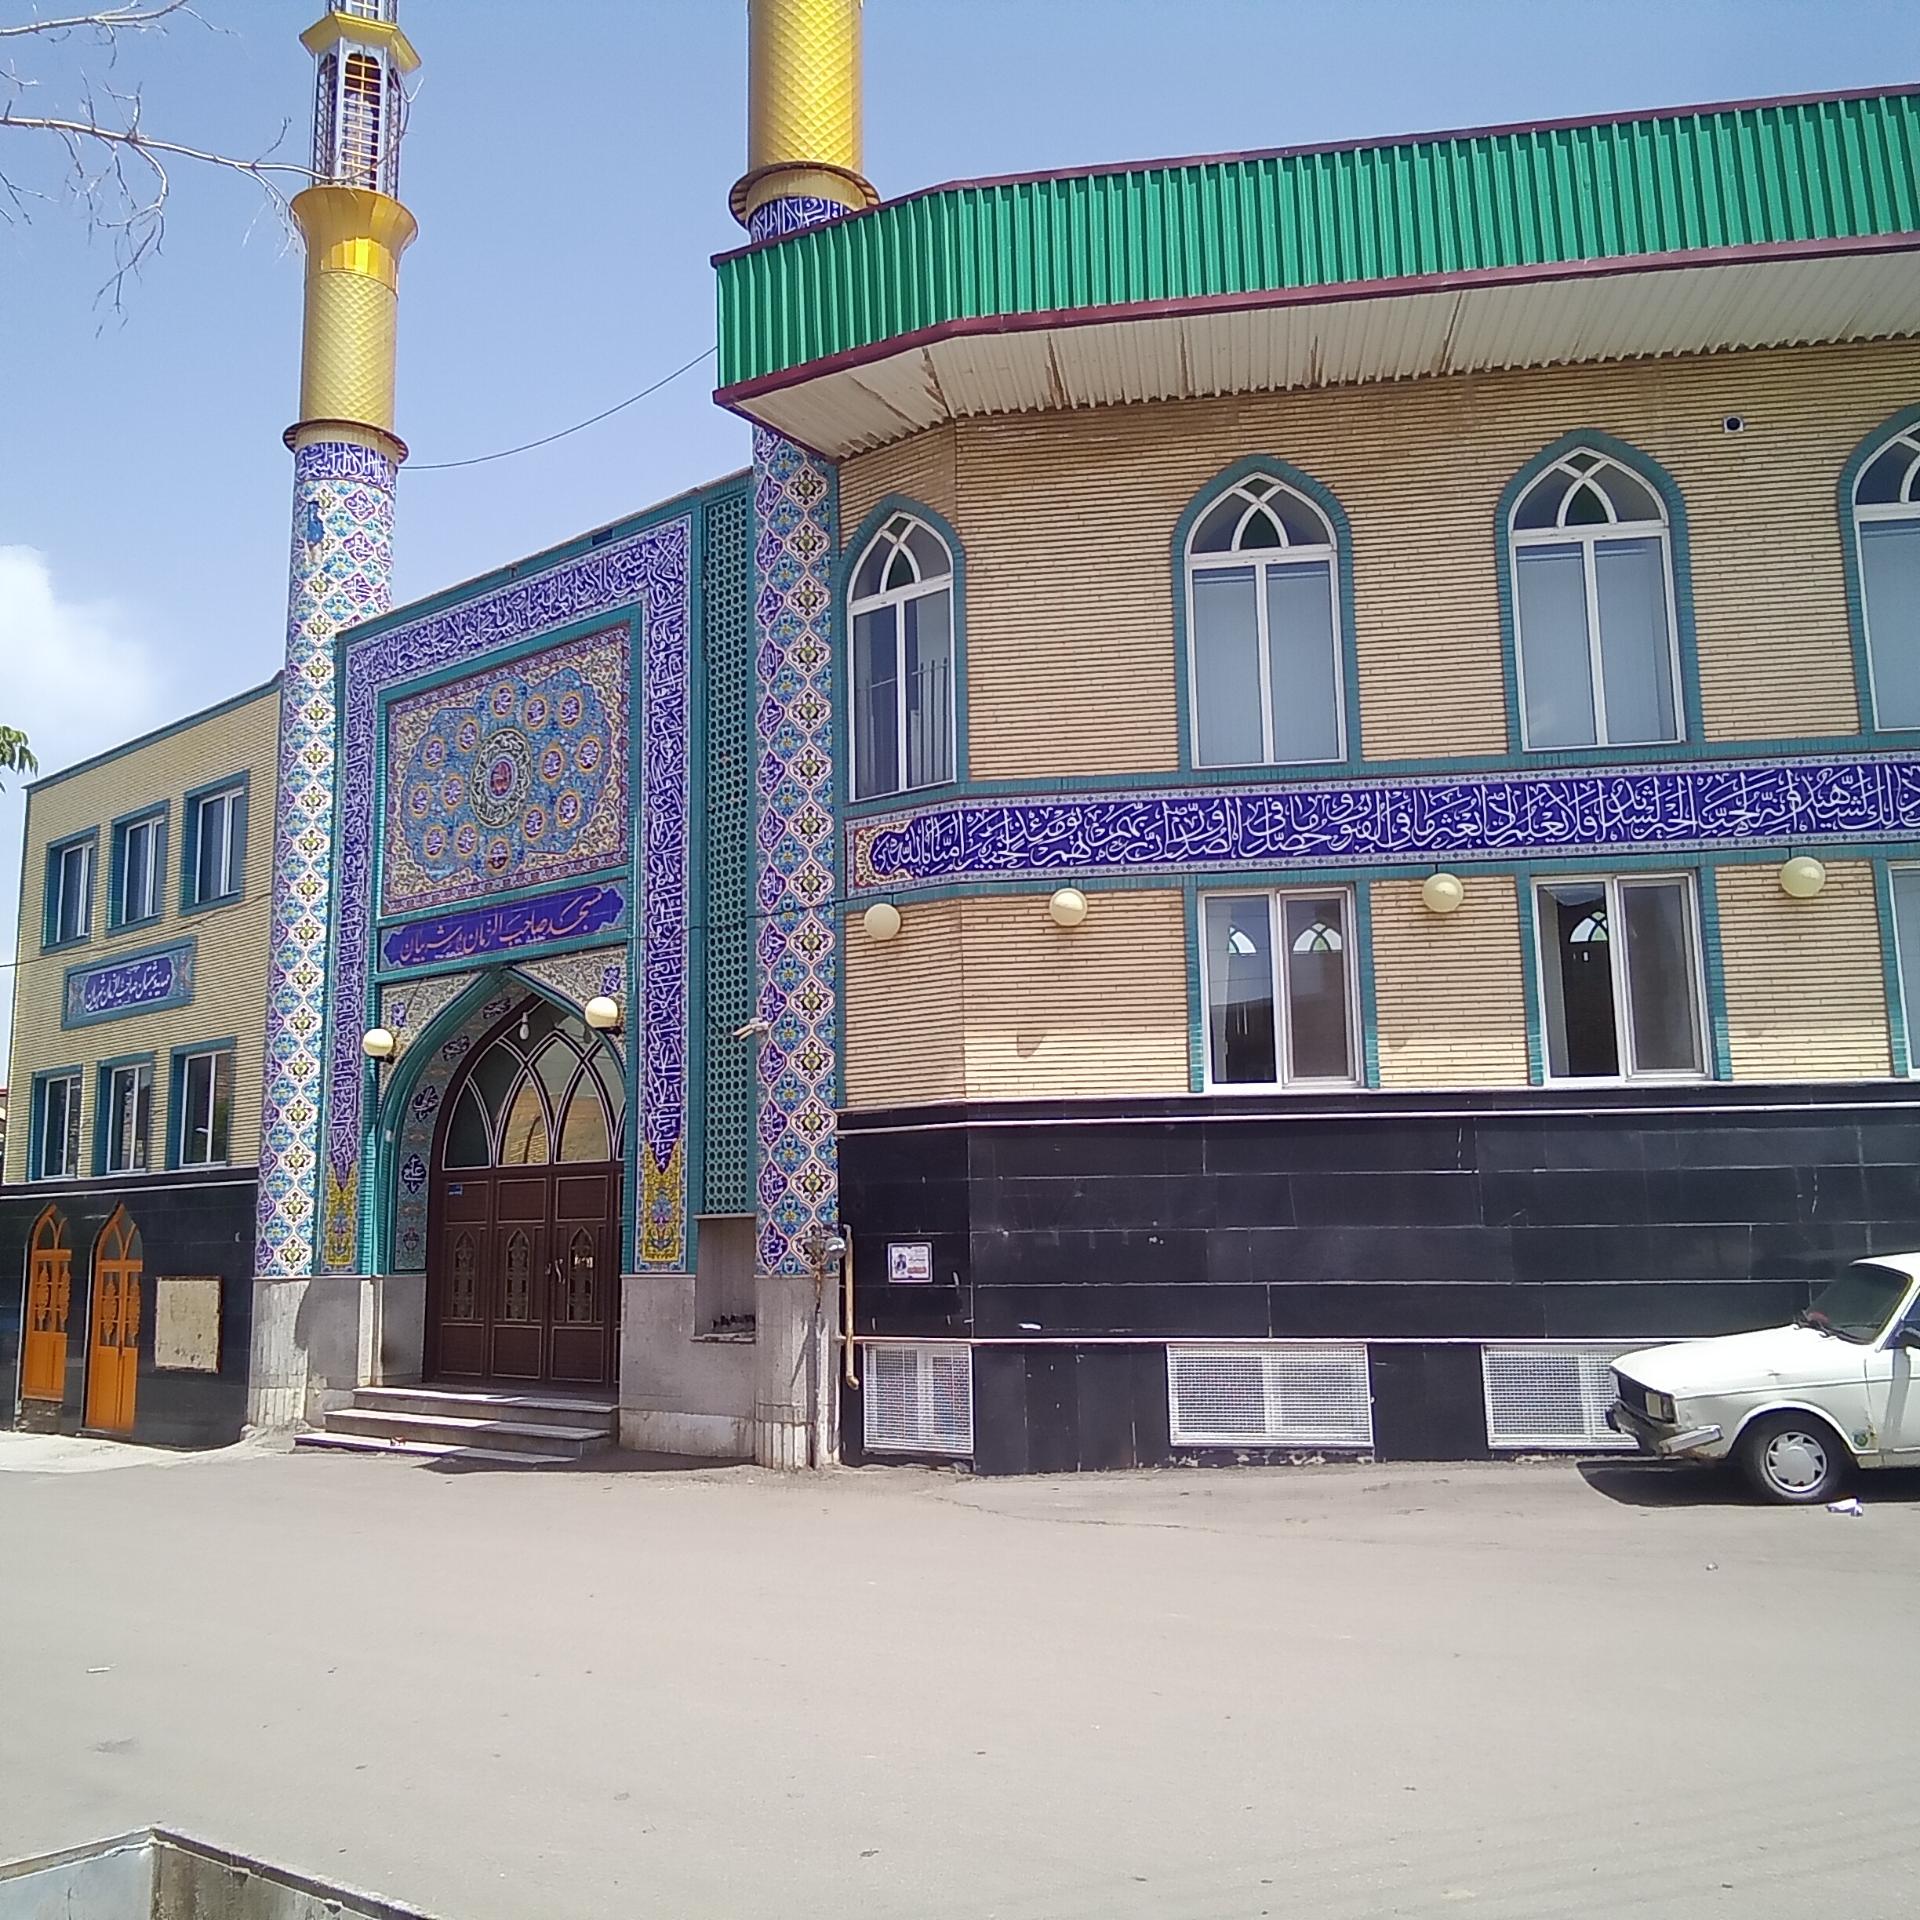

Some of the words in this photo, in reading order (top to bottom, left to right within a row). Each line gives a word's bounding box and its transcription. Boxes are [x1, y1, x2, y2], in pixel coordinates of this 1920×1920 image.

[462, 913, 503, 954] الزمان
[499, 910, 548, 946] صاحب
[546, 893, 602, 936] مسجد
